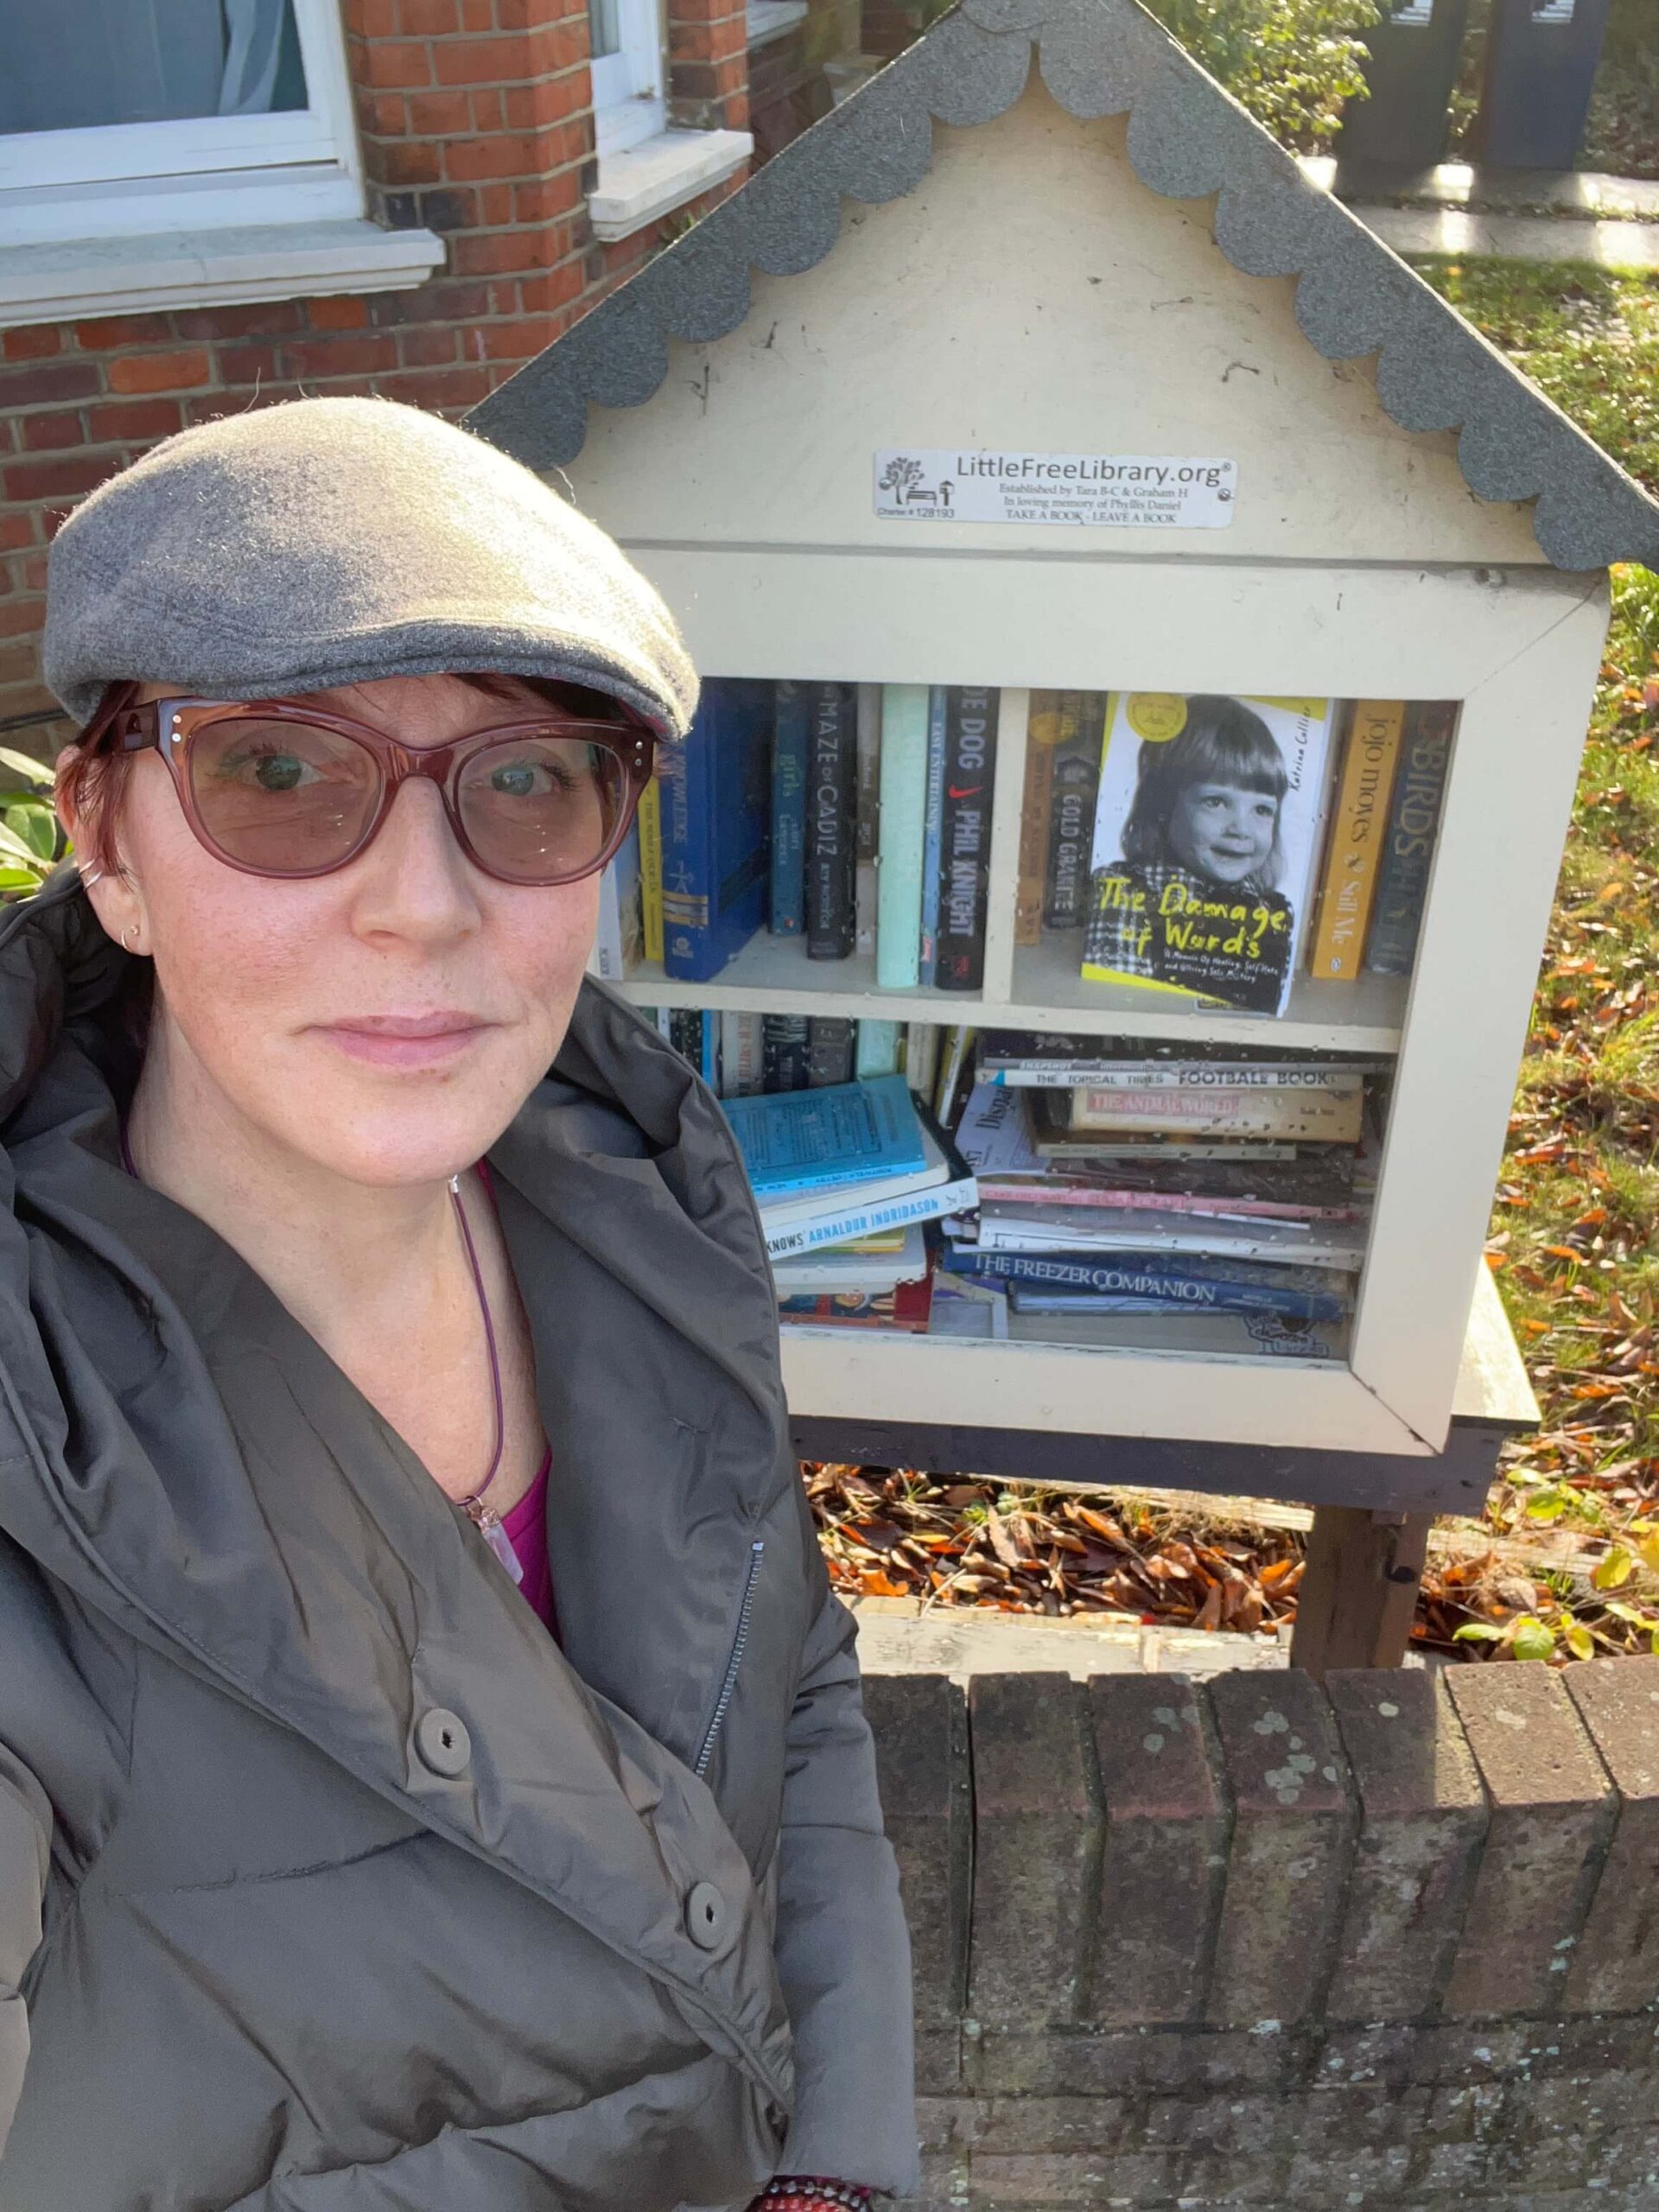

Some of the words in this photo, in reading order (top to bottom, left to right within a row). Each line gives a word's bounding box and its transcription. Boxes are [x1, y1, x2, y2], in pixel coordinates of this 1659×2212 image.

[917, 507, 955, 518] 128193
[999, 483, 1057, 496] Established
[1060, 485, 1072, 497] by
[1076, 486, 1098, 496] Tara
[1100, 486, 1121, 496] B-C
[1122, 488, 1130, 497] &
[1133, 486, 1175, 498] Graham
[1179, 487, 1189, 499] H
[1004, 496, 1014, 505] In
[1017, 496, 1049, 509] loving
[1052, 499, 1094, 510] memory
[1096, 498, 1107, 509] of
[1110, 499, 1145, 511] Phyllis
[1147, 499, 1181, 512] Daniel
[1007, 508, 1037, 520] TAKE
[1039, 510, 1048, 520] A
[1050, 510, 1083, 522] BOOK
[1092, 512, 1129, 523] LEAVE
[1132, 512, 1141, 524] A
[1143, 512, 1178, 524] BOOK
[817, 702, 839, 764] MAZE
[931, 721, 943, 752] EASY
[957, 717, 987, 771] DOG
[1294, 705, 1311, 745] Collier
[1363, 712, 1396, 761] jojo
[1287, 748, 1305, 792] Katrina
[817, 785, 839, 856] CADIZ
[1348, 767, 1380, 845] moyes
[1394, 744, 1446, 858] BIRDS
[953, 810, 982, 856] PHIL
[949, 860, 978, 938] KNIGHT
[1054, 842, 1078, 912] GRANITE
[1336, 880, 1361, 912] Still
[1100, 876, 1146, 912] The
[1158, 883, 1287, 939] Damage
[1122, 925, 1153, 957] of
[1166, 918, 1262, 959] Words
[1331, 916, 1354, 945] Me
[1212, 957, 1240, 969] Healing
[1036, 1073, 1058, 1084] THE
[1068, 1074, 1117, 1086] TOPICAL
[1127, 1074, 1164, 1086] TIMES
[1179, 1071, 1268, 1085] FOOTBALL
[1277, 1071, 1329, 1085] BOOK
[1092, 1092, 1122, 1110] THE
[1122, 1093, 1180, 1113] ANIMAL
[1181, 1096, 1236, 1115] WORLD
[766, 1232, 804, 1255] KNOWS
[809, 1217, 868, 1243] ARNALDUR
[871, 1198, 939, 1228] INDRIDASON
[974, 1253, 1010, 1273] THE
[1014, 1258, 1091, 1285] FREEZER
[1091, 1268, 1217, 1302] COMPANION
